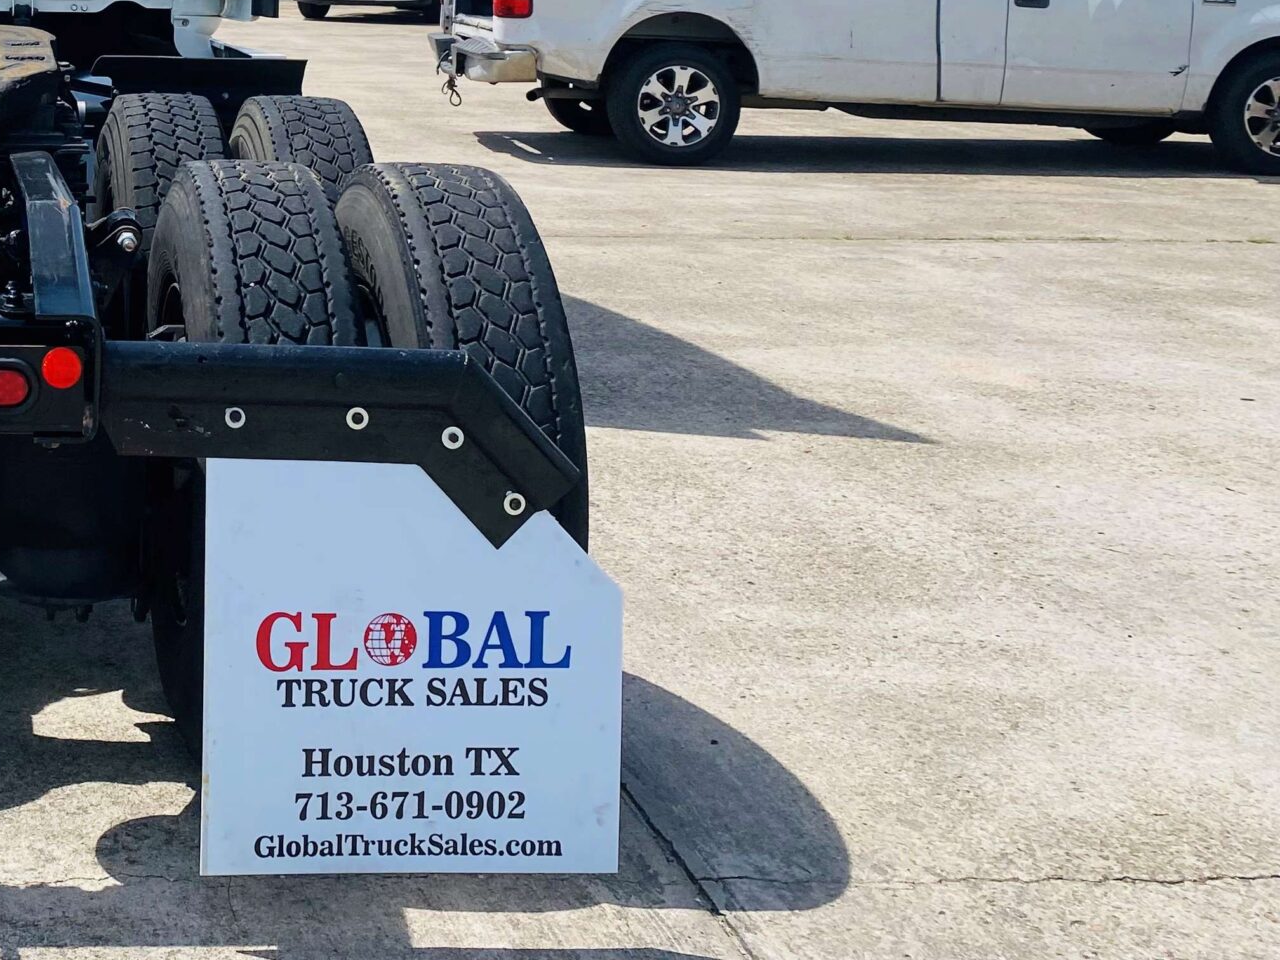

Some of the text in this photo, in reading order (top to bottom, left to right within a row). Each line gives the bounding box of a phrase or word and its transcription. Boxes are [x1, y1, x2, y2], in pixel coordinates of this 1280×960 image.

[277, 678, 549, 707] TRUCK SALES
[302, 748, 520, 777] Houston TX
[295, 791, 526, 821] 713-671-0902
[254, 833, 562, 858] GlobalTruckSales.com
